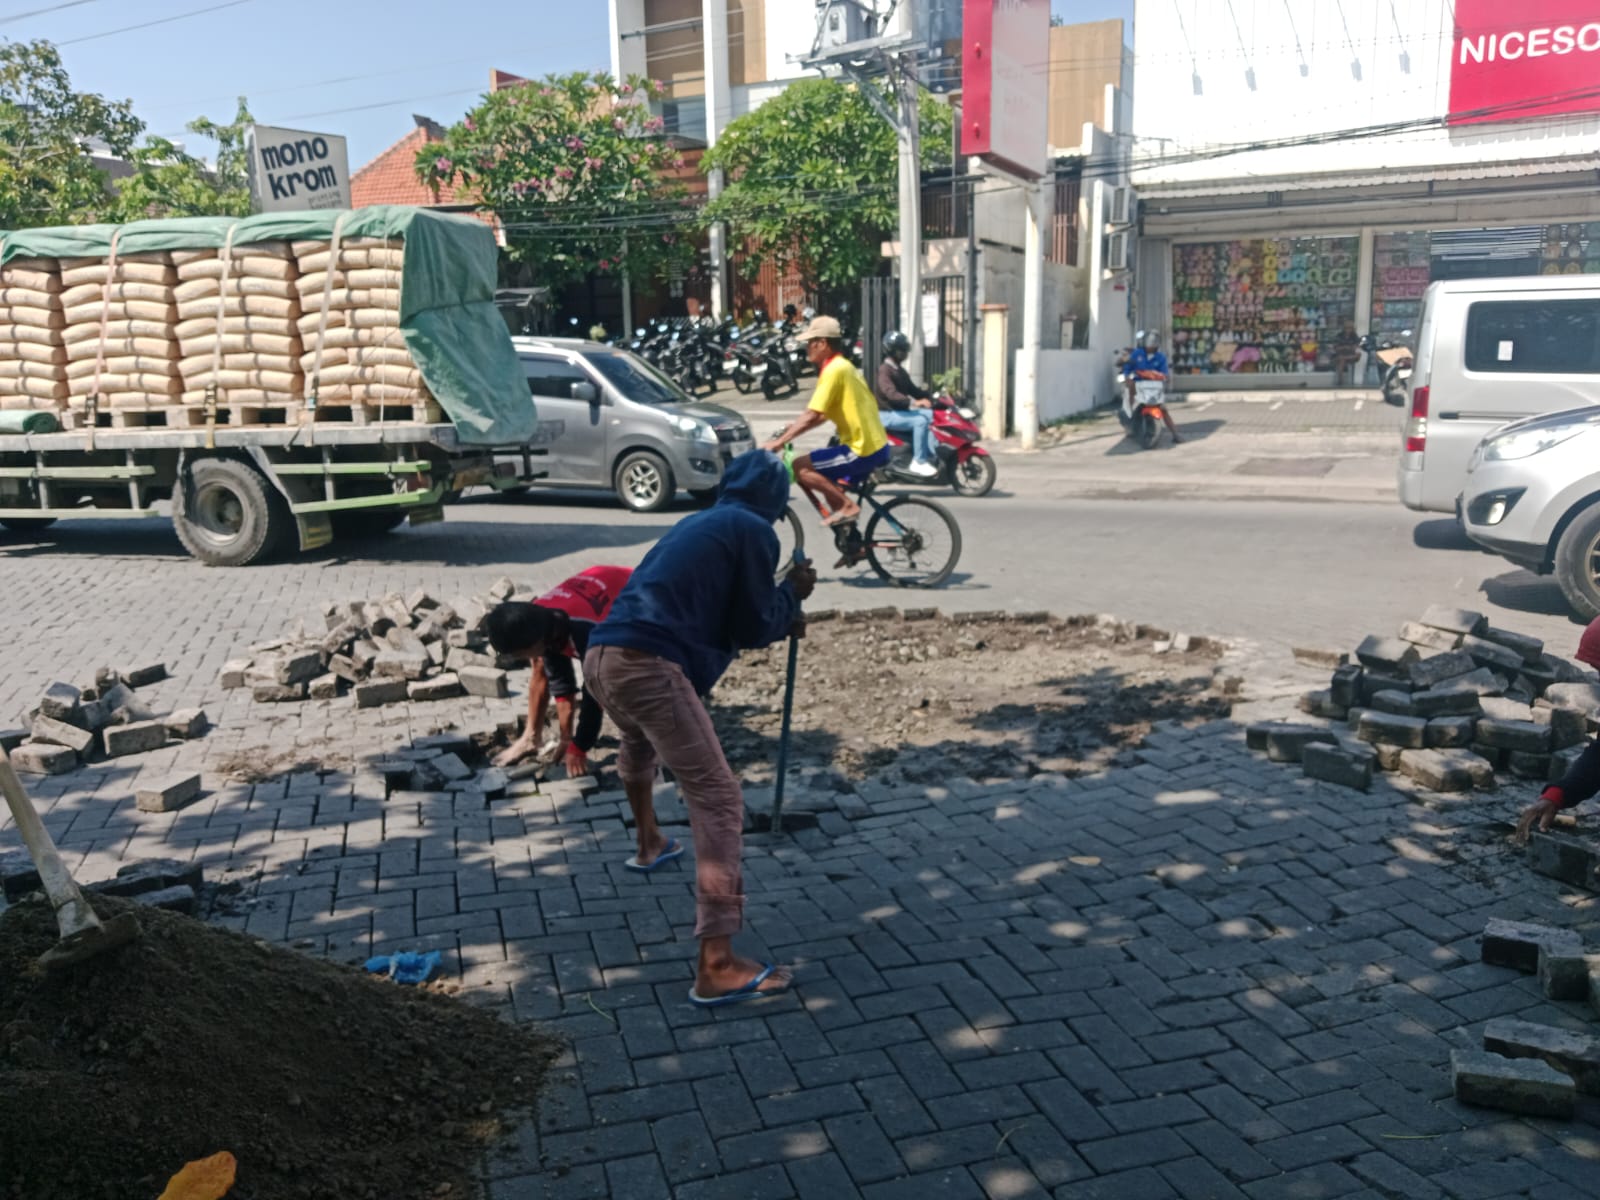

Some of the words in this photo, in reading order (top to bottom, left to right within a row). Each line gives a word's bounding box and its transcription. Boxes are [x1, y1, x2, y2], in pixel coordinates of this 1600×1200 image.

[1460, 23, 1600, 65] NICESO
[261, 136, 328, 171] mono
[268, 164, 337, 200] krom
